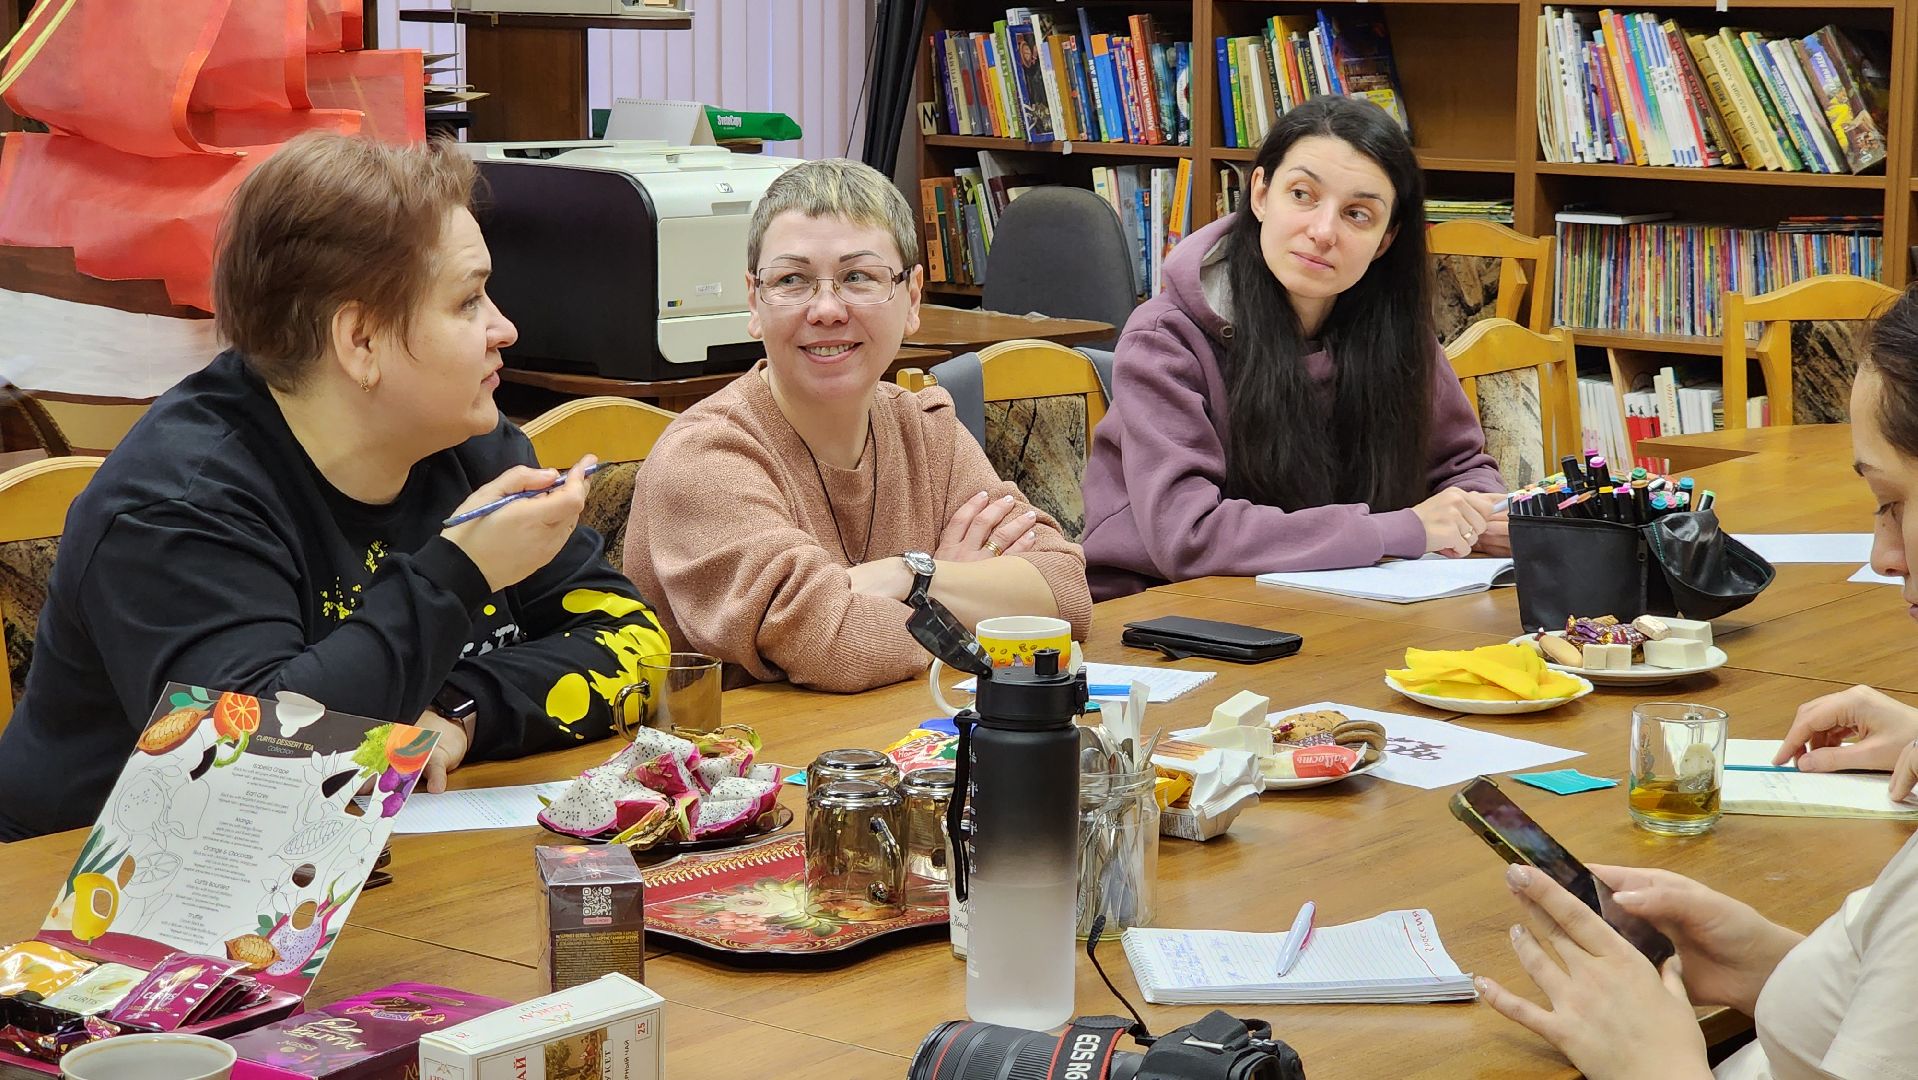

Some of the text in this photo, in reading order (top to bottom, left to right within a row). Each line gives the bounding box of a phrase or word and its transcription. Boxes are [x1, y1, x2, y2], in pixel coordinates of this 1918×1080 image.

[1136, 59, 1155, 130] Алексей ТОЛСТОЙ
[717, 114, 742, 127] SvetoCopy
[256, 735, 315, 752] CURTIS DESSERT TEA
[638, 1022, 646, 1035] 25
[1064, 1034, 1101, 1080] EOS R6
[514, 1056, 527, 1080] АЙ
